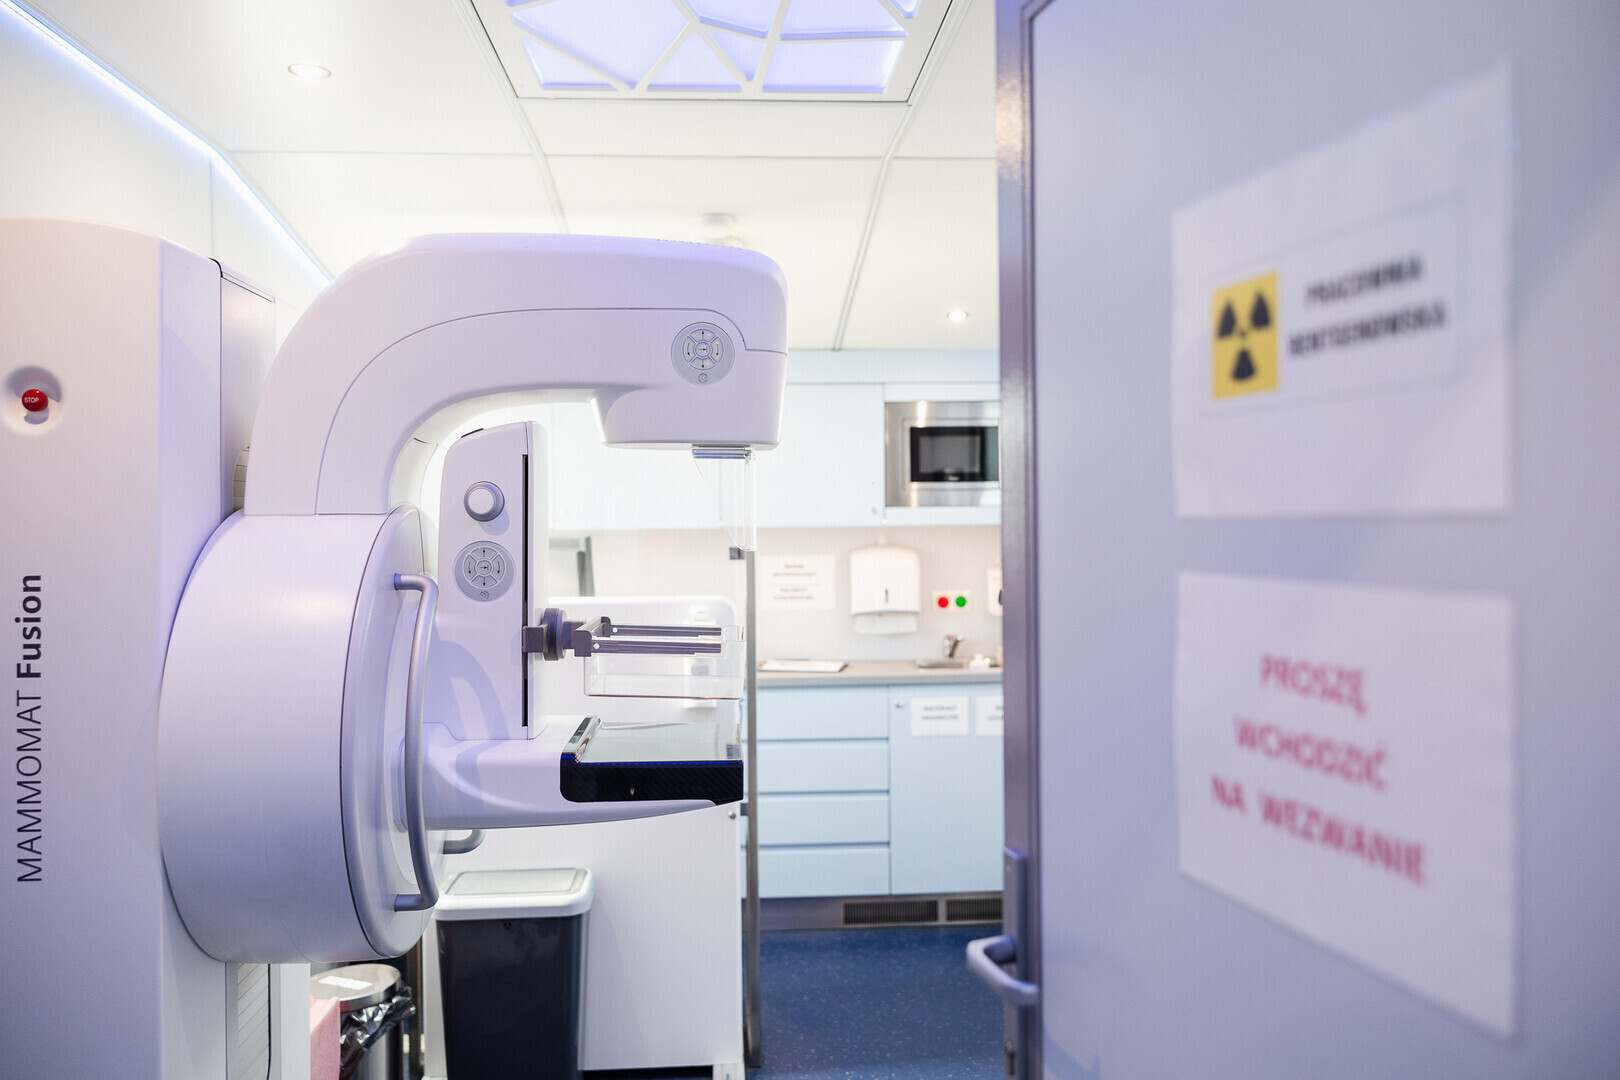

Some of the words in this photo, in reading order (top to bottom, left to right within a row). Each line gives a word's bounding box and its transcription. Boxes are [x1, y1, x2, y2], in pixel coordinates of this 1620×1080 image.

[15, 574, 42, 679] Fusion
[1261, 655, 1367, 714] PROSZĘ
[16, 690, 42, 882] MAMMOMAT
[1236, 719, 1387, 790] WCHODZIĆ
[1212, 775, 1245, 814] NA
[1261, 794, 1426, 887] WEZWANIE
